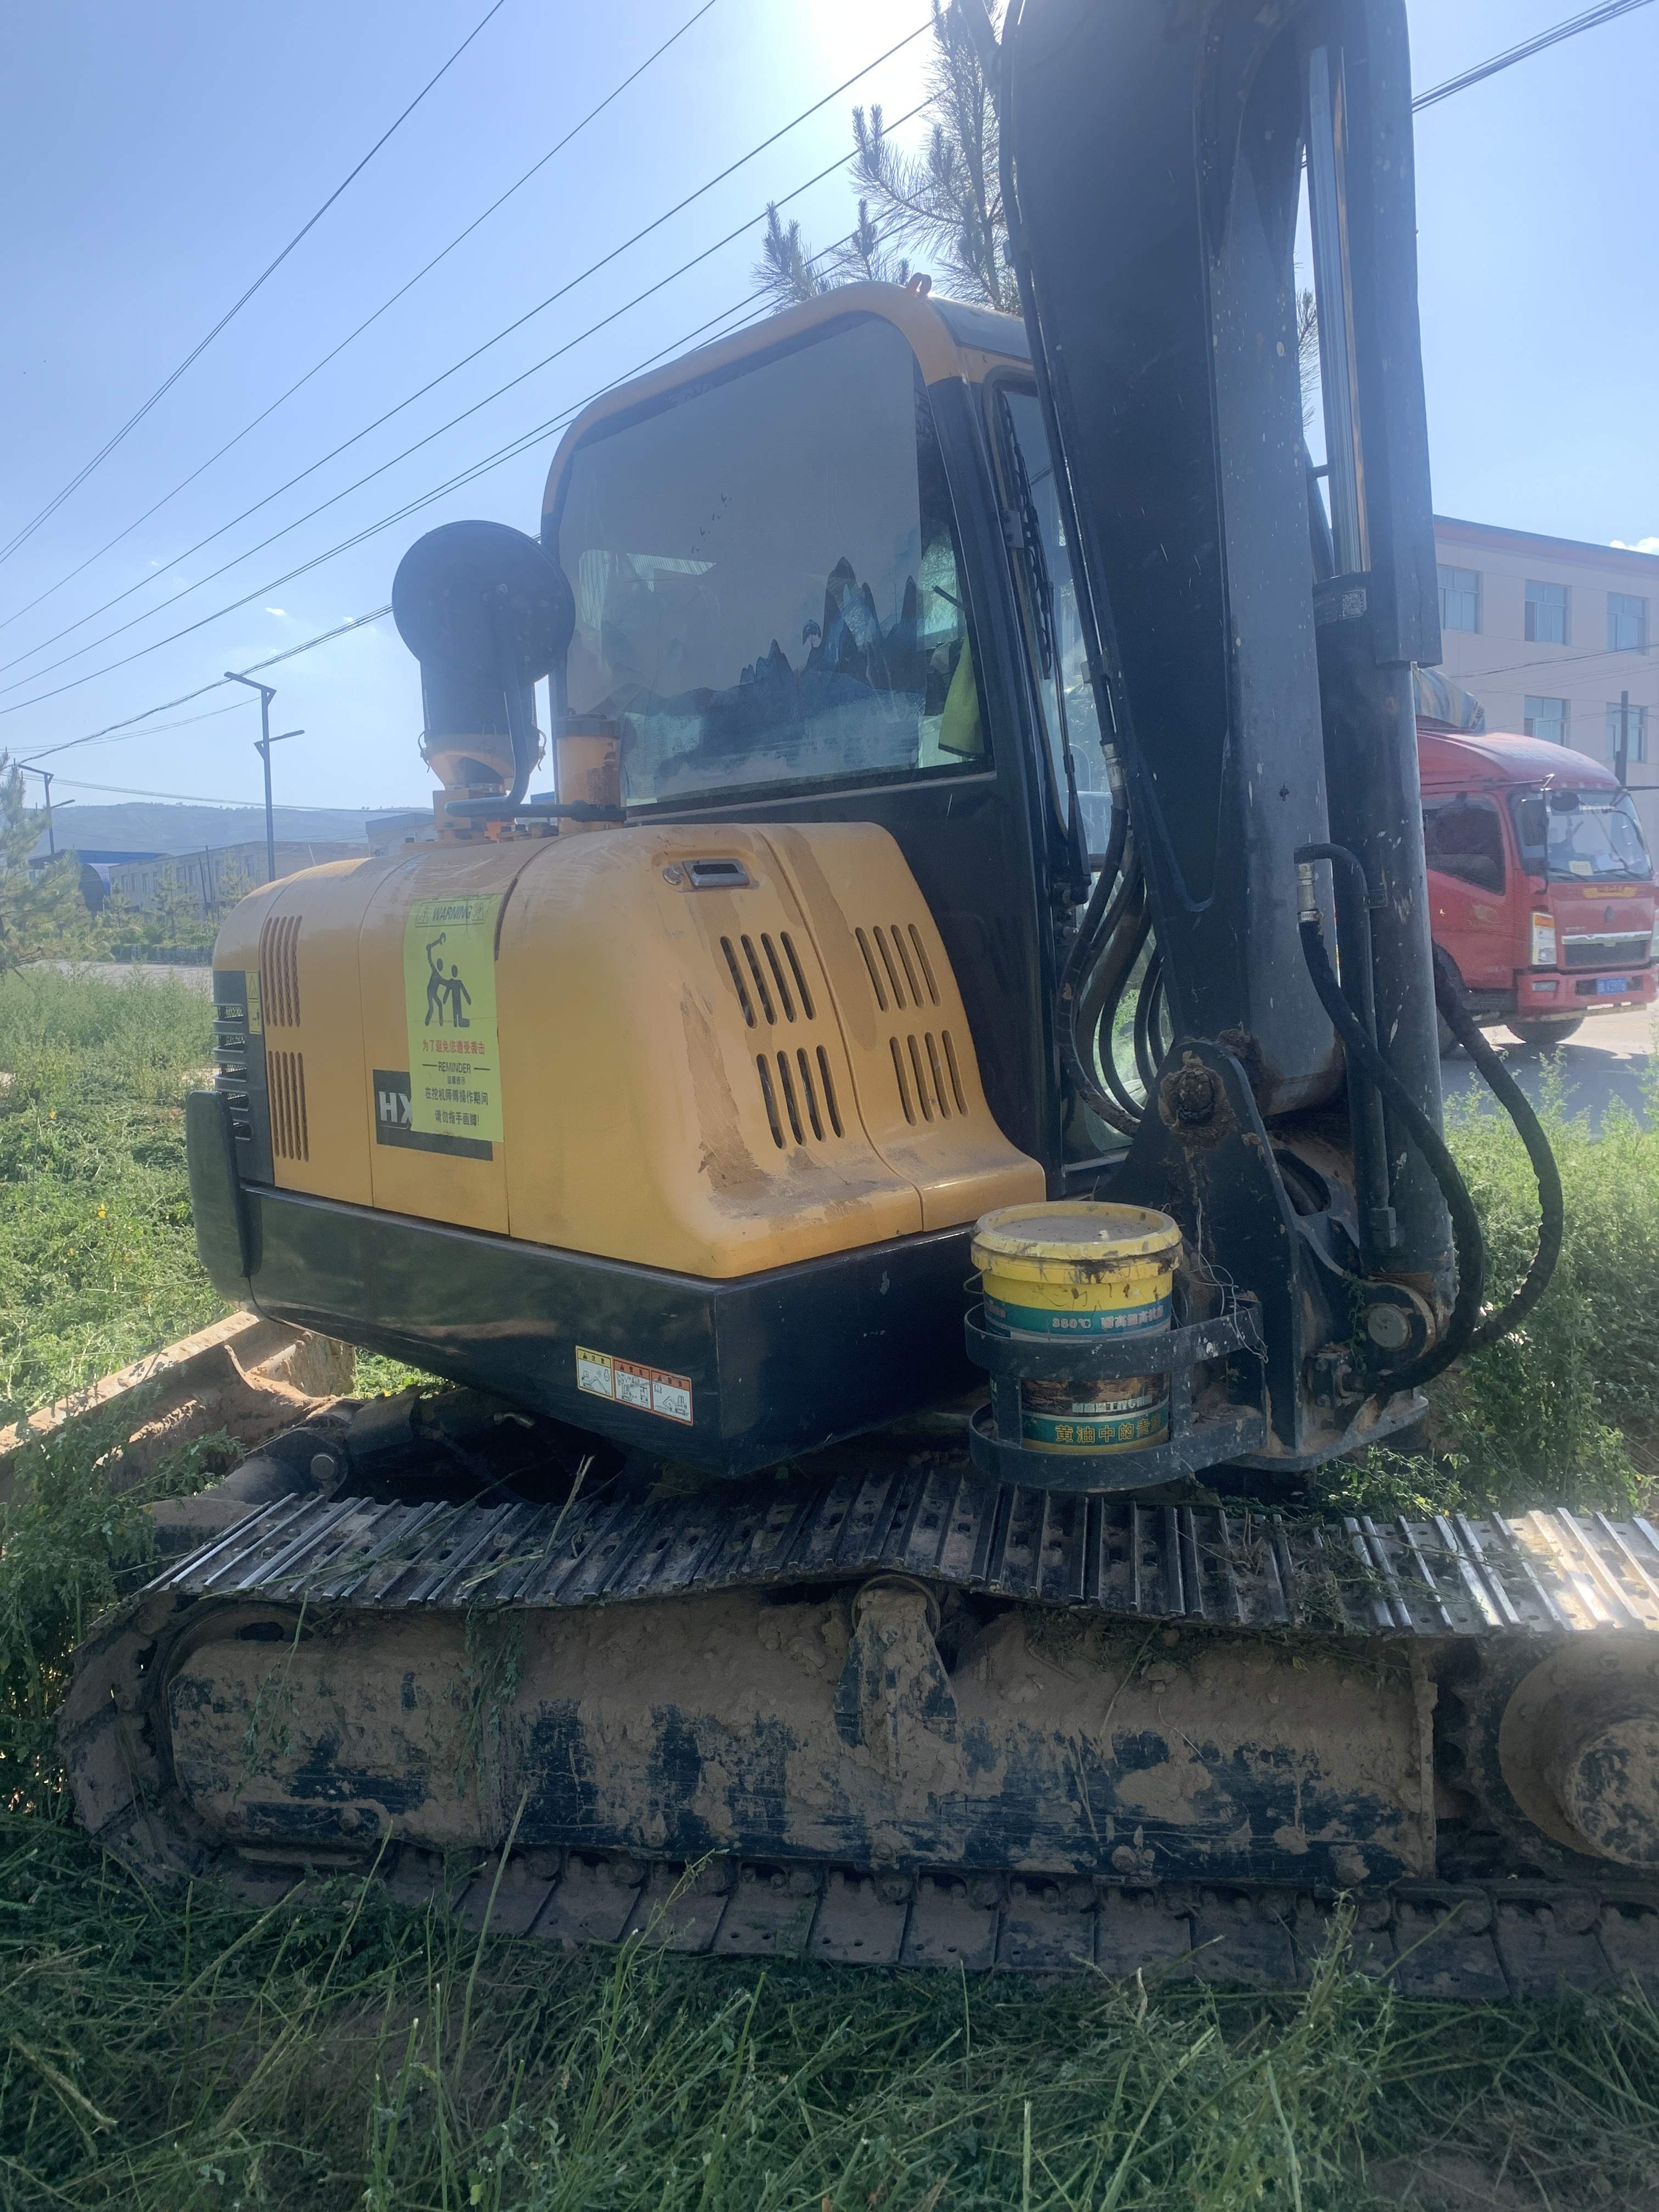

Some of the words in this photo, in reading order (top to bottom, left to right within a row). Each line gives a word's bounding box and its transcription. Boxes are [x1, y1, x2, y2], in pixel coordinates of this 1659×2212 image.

[433, 905, 472, 921] WARNING
[438, 1062, 471, 1074] REMINDER
[425, 1087, 488, 1105] 在挖机师傅操作期间
